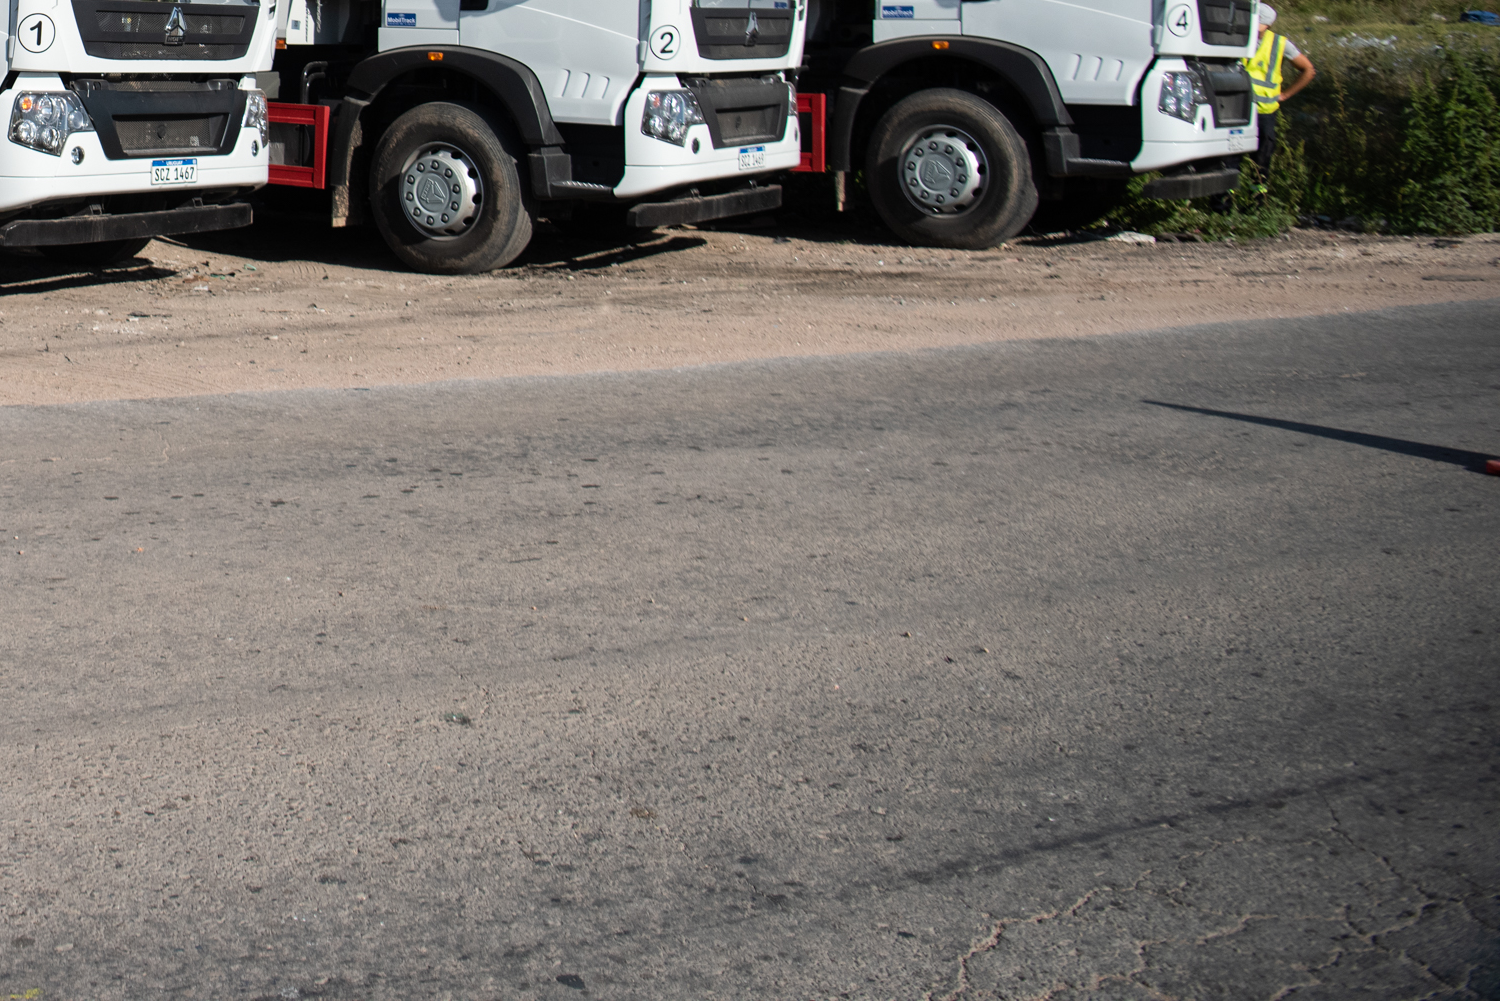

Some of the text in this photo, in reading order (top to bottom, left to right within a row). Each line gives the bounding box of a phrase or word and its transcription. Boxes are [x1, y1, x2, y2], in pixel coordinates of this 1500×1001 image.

[1176, 9, 1188, 31] 4
[30, 20, 42, 46] 1
[660, 31, 673, 54] 2
[155, 166, 195, 181] SCZ 1467
